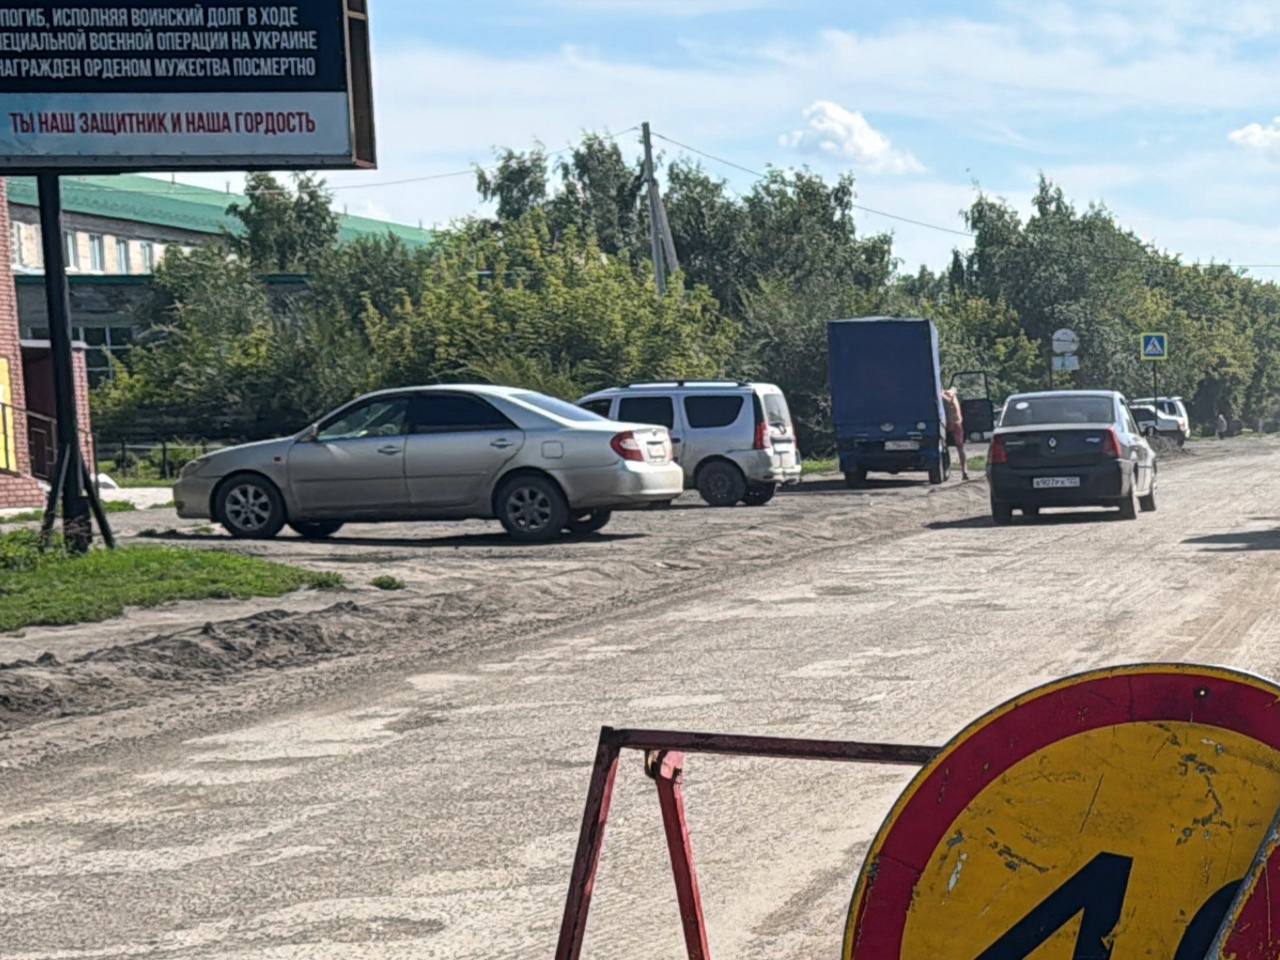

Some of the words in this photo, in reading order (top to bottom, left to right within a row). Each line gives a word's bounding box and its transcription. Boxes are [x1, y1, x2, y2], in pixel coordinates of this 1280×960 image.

[0, 8, 49, 29] ПОГИБ,
[52, 8, 128, 27] ИСПОЛНЯЯ
[131, 4, 204, 27] ВОИНСКИЙ
[207, 7, 244, 28] ДОЛГ
[248, 7, 257, 25] В
[260, 6, 299, 27] ХОДЕ
[89, 28, 154, 51] ВОЕННОЙ
[156, 31, 229, 52] ОПЕРАЦИИ
[231, 31, 251, 50] НА
[253, 30, 318, 50] УКРАИНЕ
[84, 58, 151, 79] ОРДЕНОМ
[154, 57, 231, 77] МУЖЕСТВА
[233, 57, 316, 77] ПОСМЕРТНО
[9, 112, 35, 134] ТЫ
[38, 112, 75, 134] НАШ
[79, 112, 168, 136] ЗАЩИТНИК
[171, 112, 182, 133] И
[185, 112, 232, 133] НАША
[234, 112, 316, 135] ГОРДОСТЬ
